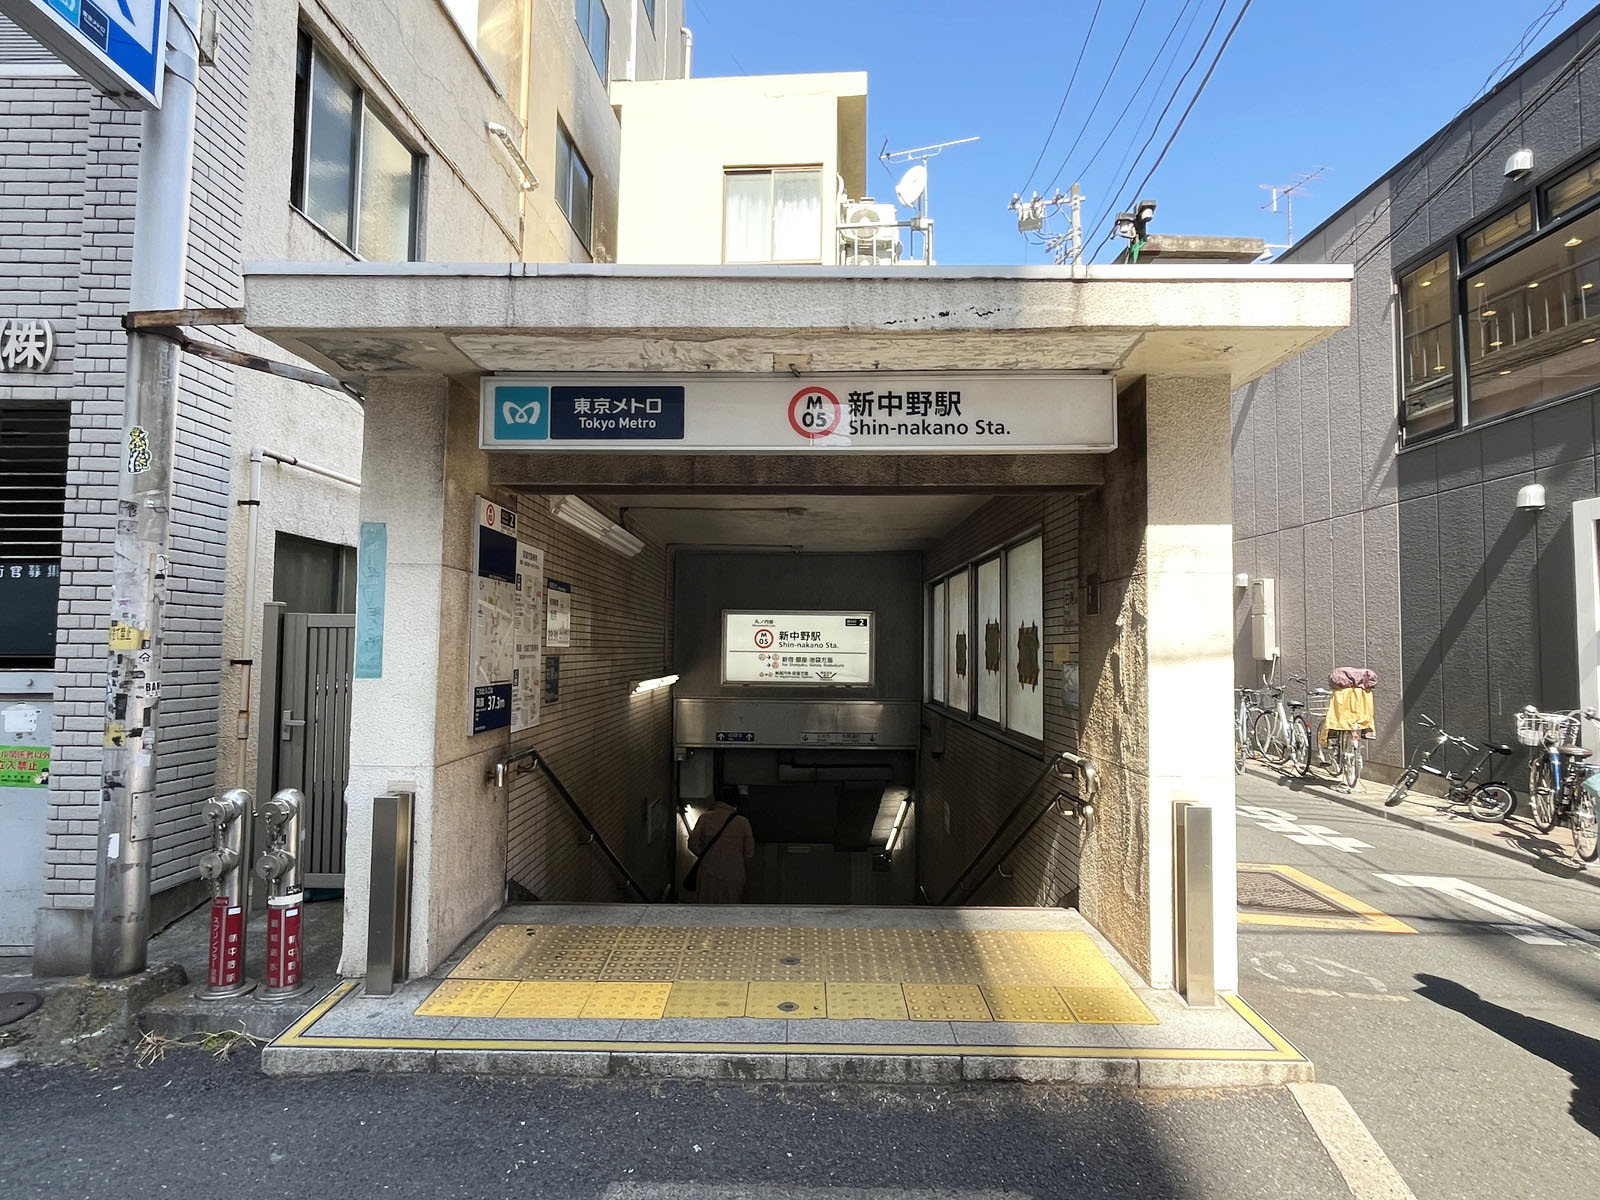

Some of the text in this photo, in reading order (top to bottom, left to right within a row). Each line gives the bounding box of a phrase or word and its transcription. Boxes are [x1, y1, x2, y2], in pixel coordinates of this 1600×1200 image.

[573, 397, 662, 415] 東京メトロ
[806, 395, 823, 410] M
[848, 390, 962, 417] 新中野駅
[578, 417, 657, 431] Tokyo Metro
[801, 412, 827, 428] 05
[849, 419, 1011, 436] Shin-nakano Sta.
[858, 619, 865, 627] 2
[779, 631, 821, 641] 新中野駅
